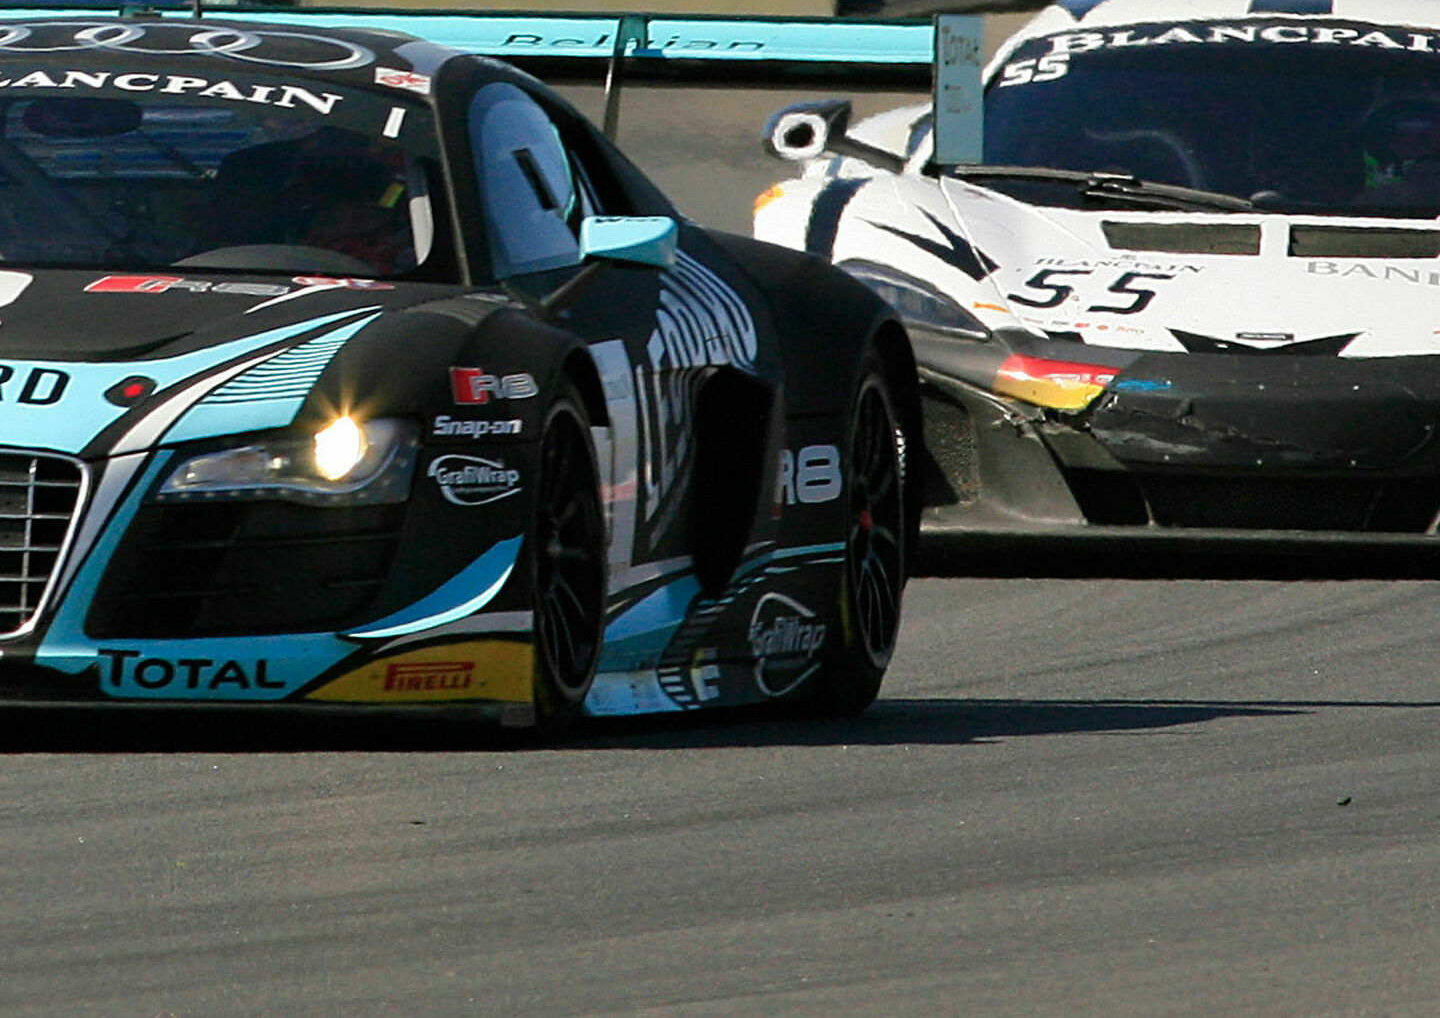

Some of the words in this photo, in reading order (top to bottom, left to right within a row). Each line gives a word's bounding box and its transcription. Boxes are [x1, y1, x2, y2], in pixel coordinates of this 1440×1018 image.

[502, 33, 765, 51] Belian
[1047, 25, 1440, 55] BLANCPAI
[999, 53, 1070, 87] 55
[1007, 268, 1177, 315] 55
[433, 415, 523, 439] Snap-on
[775, 444, 843, 506] R8
[98, 649, 286, 690] TOTAL
[383, 661, 475, 691] PIRELLI
